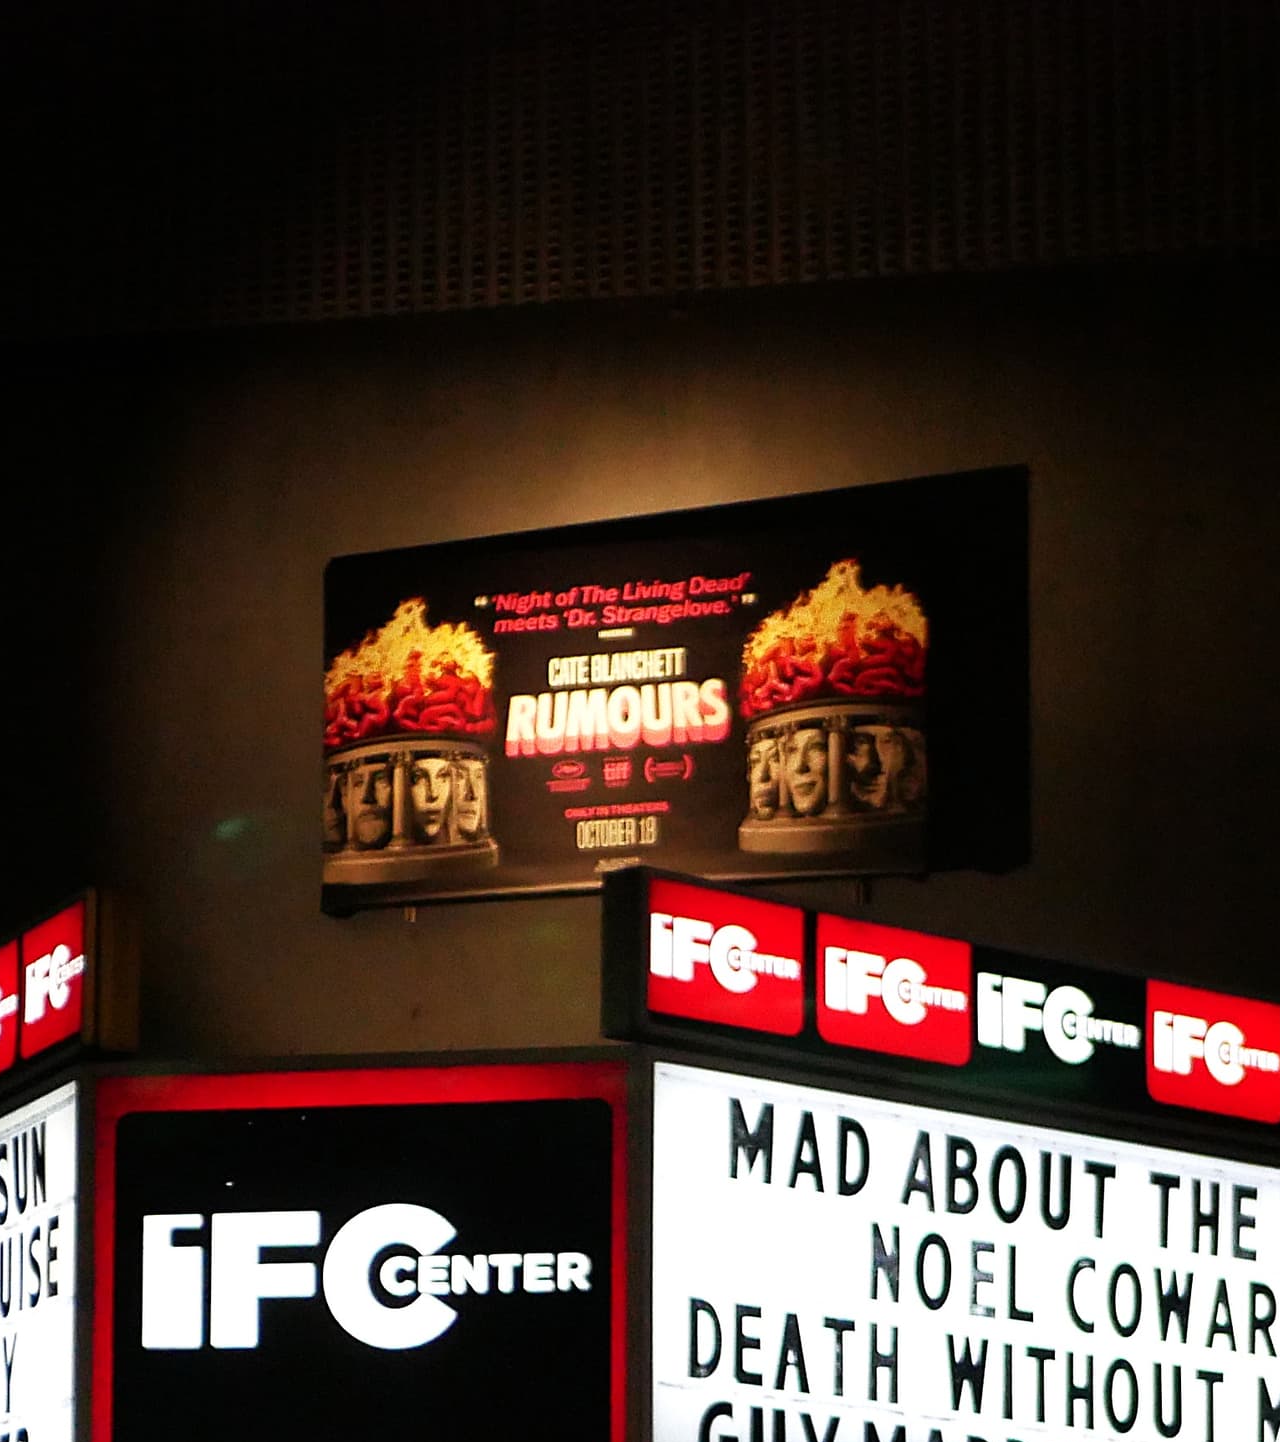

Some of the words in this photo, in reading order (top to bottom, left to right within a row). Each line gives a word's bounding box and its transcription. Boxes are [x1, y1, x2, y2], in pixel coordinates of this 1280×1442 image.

[554, 586, 580, 606] of
[582, 584, 619, 604] The
[622, 577, 686, 604] Living
[494, 613, 558, 633] meets
[547, 655, 589, 687] CATE
[590, 647, 686, 685] BLANCHETT
[505, 678, 731, 758] RUMOURS
[576, 817, 636, 849] OCTOBER
[1061, 1011, 1142, 1050] CENTER
[1218, 1041, 1280, 1072] CENTER
[727, 1096, 870, 1197] MAD
[901, 1129, 1117, 1238] ABOUT
[1148, 1170, 1258, 1262] THE
[379, 1252, 593, 1297] CENTER
[869, 1221, 1034, 1324] NOEL
[686, 1296, 901, 1405] DEATH
